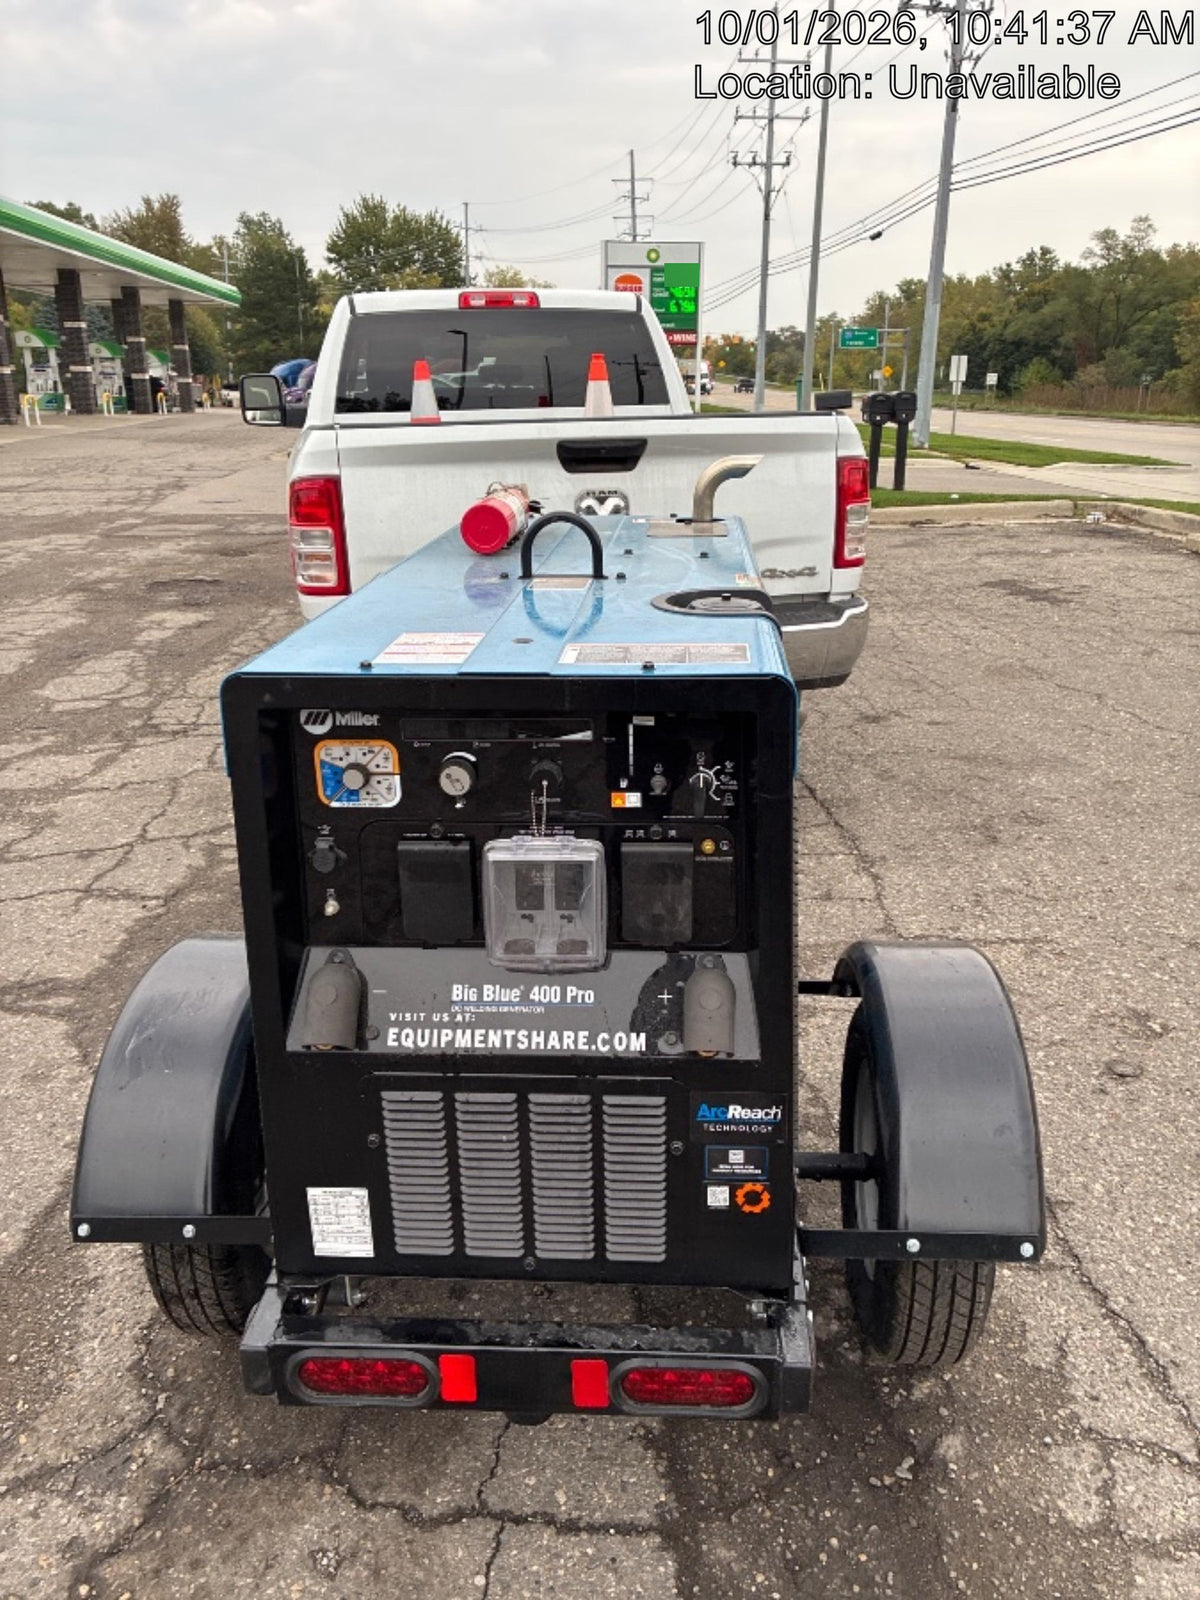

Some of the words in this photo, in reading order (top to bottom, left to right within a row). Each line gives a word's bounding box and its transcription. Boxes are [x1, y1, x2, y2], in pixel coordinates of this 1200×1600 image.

[335, 710, 379, 727] Miller
[451, 984, 478, 1003] Big
[529, 985, 561, 1004] 400
[566, 986, 595, 1004] Pro
[389, 1012, 425, 1022] VISIT
[432, 1012, 450, 1023] US
[454, 1013, 476, 1023] AT:
[386, 1027, 647, 1052] EQUIPMENTSHARE.COM
[696, 1103, 782, 1120] ArcReach
[703, 1123, 773, 1133] TECHNOLOGY
